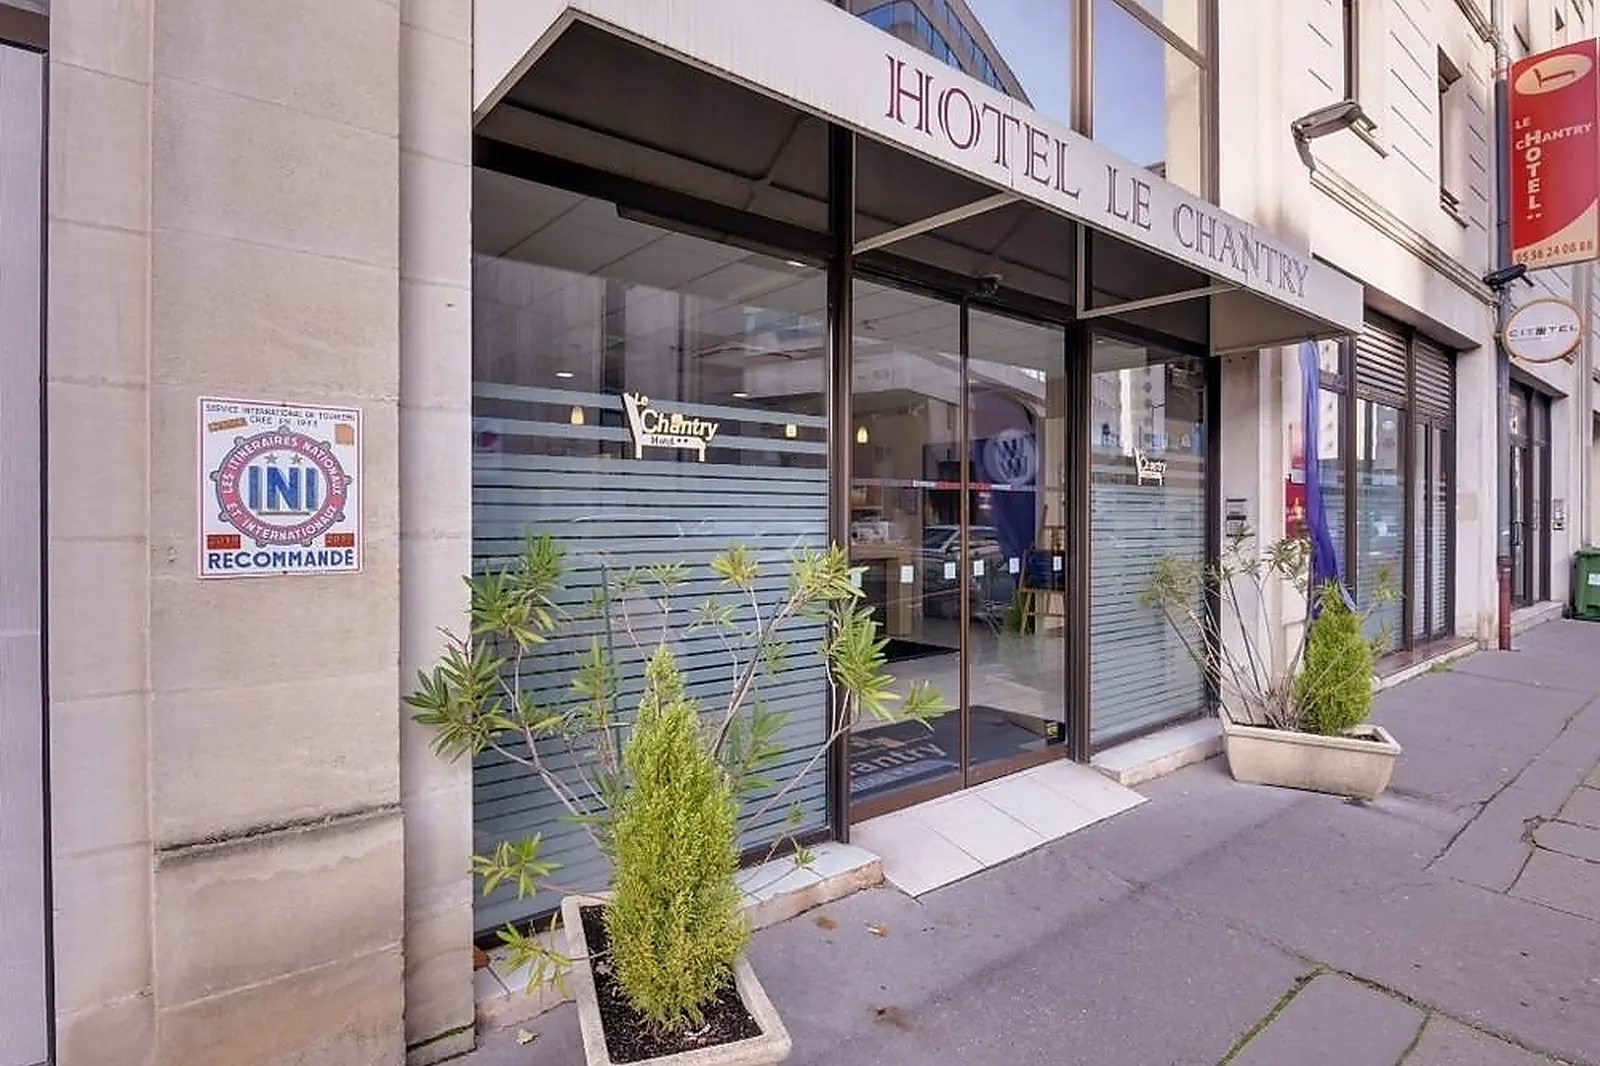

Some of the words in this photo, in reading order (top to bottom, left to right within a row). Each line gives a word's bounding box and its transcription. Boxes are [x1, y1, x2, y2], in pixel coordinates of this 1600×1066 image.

[1515, 116, 1531, 129] LE
[884, 54, 1081, 200] HOTEL
[1104, 164, 1152, 231] LE
[1172, 202, 1309, 300] CHANTRY
[1524, 129, 1542, 210] HOTEL
[634, 392, 649, 406] Le
[641, 409, 719, 441] Chantry
[221, 471, 235, 494] LES
[303, 440, 342, 496] NATIONAUX
[249, 465, 319, 511] INI
[225, 503, 239, 518] ET
[241, 504, 336, 541] INTERNATIONAUX
